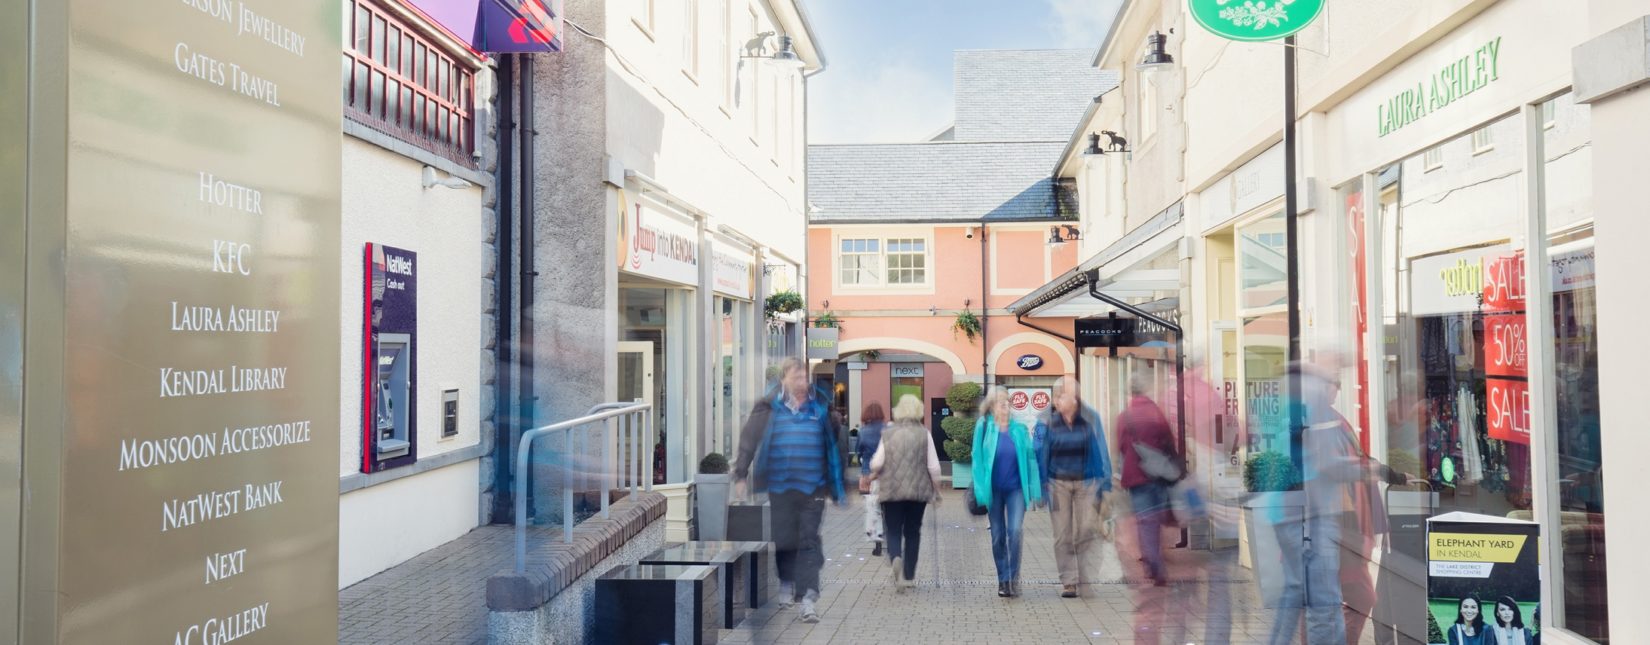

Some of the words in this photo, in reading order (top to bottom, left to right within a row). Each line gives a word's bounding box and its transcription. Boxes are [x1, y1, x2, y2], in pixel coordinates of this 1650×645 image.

[238, 3, 306, 57] JEWELLERY
[174, 42, 225, 86] GATES
[229, 63, 280, 107] TRAVEL
[1378, 81, 1426, 138] LAURA
[1429, 36, 1502, 113] ASHLEY
[199, 172, 262, 215] HOTTER
[633, 203, 656, 262] Jump
[670, 232, 697, 266] KENDAL
[212, 239, 251, 276] KFC
[386, 254, 412, 276] NatWest
[1487, 256, 1526, 302] SALE
[171, 301, 224, 331] LAURA
[227, 304, 281, 333] ASHLEY
[1493, 323, 1525, 366] 50%
[159, 368, 226, 398] KENDAL
[231, 366, 287, 392] LIBRARY
[895, 367, 920, 375] next
[1224, 381, 1279, 398] PITURE
[1225, 399, 1279, 415] FRMING
[1490, 387, 1530, 433] SALE
[118, 431, 217, 472] MONSOON
[219, 420, 311, 456] ACCESSORIZE
[244, 480, 283, 512] BANK
[1436, 538, 1486, 548] ELEPHANT
[1488, 540, 1515, 549] YARD
[1436, 549, 1446, 557] IN
[1448, 550, 1482, 559] KENDAL
[204, 548, 247, 585] NEXT
[203, 602, 270, 645] GALLERY
